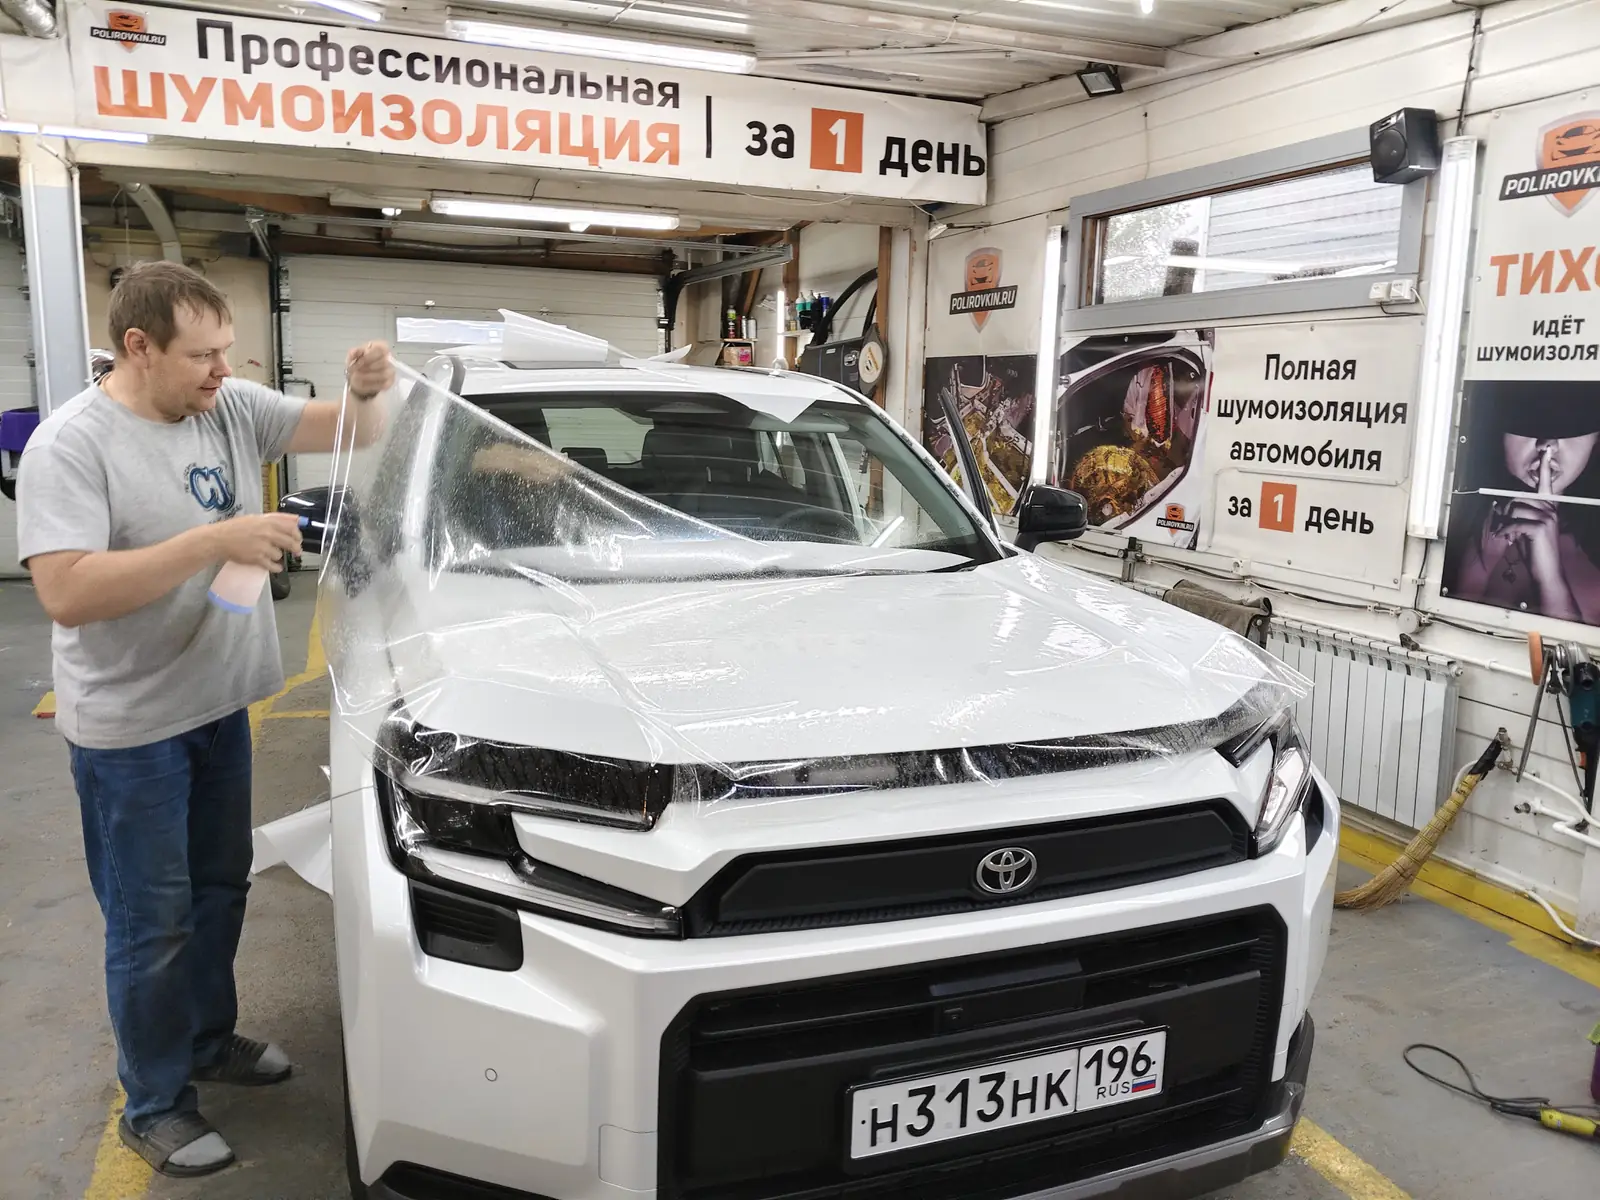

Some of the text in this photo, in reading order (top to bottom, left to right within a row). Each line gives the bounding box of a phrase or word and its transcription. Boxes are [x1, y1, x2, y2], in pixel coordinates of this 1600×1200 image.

[92, 29, 165, 45] POLIROVKIN.RU
[197, 20, 680, 109] Профессиональная
[93, 65, 680, 167] ШУМОИЗОЛЯЦИЯ
[745, 118, 986, 178] за 1 день
[1490, 246, 1600, 296] ТИХ
[951, 290, 1016, 310] POLIROVKIN.RU
[1532, 314, 1585, 338] ИДЁТ
[1264, 354, 1357, 381] Полная
[1476, 344, 1598, 362] ШУМОИЗОЛЯ
[1217, 398, 1408, 428] шумоизоляция
[1229, 439, 1382, 471] автомобиля
[1227, 493, 1375, 536] за 1 день
[1085, 1040, 1151, 1085] 196
[1096, 1081, 1131, 1100] RUS
